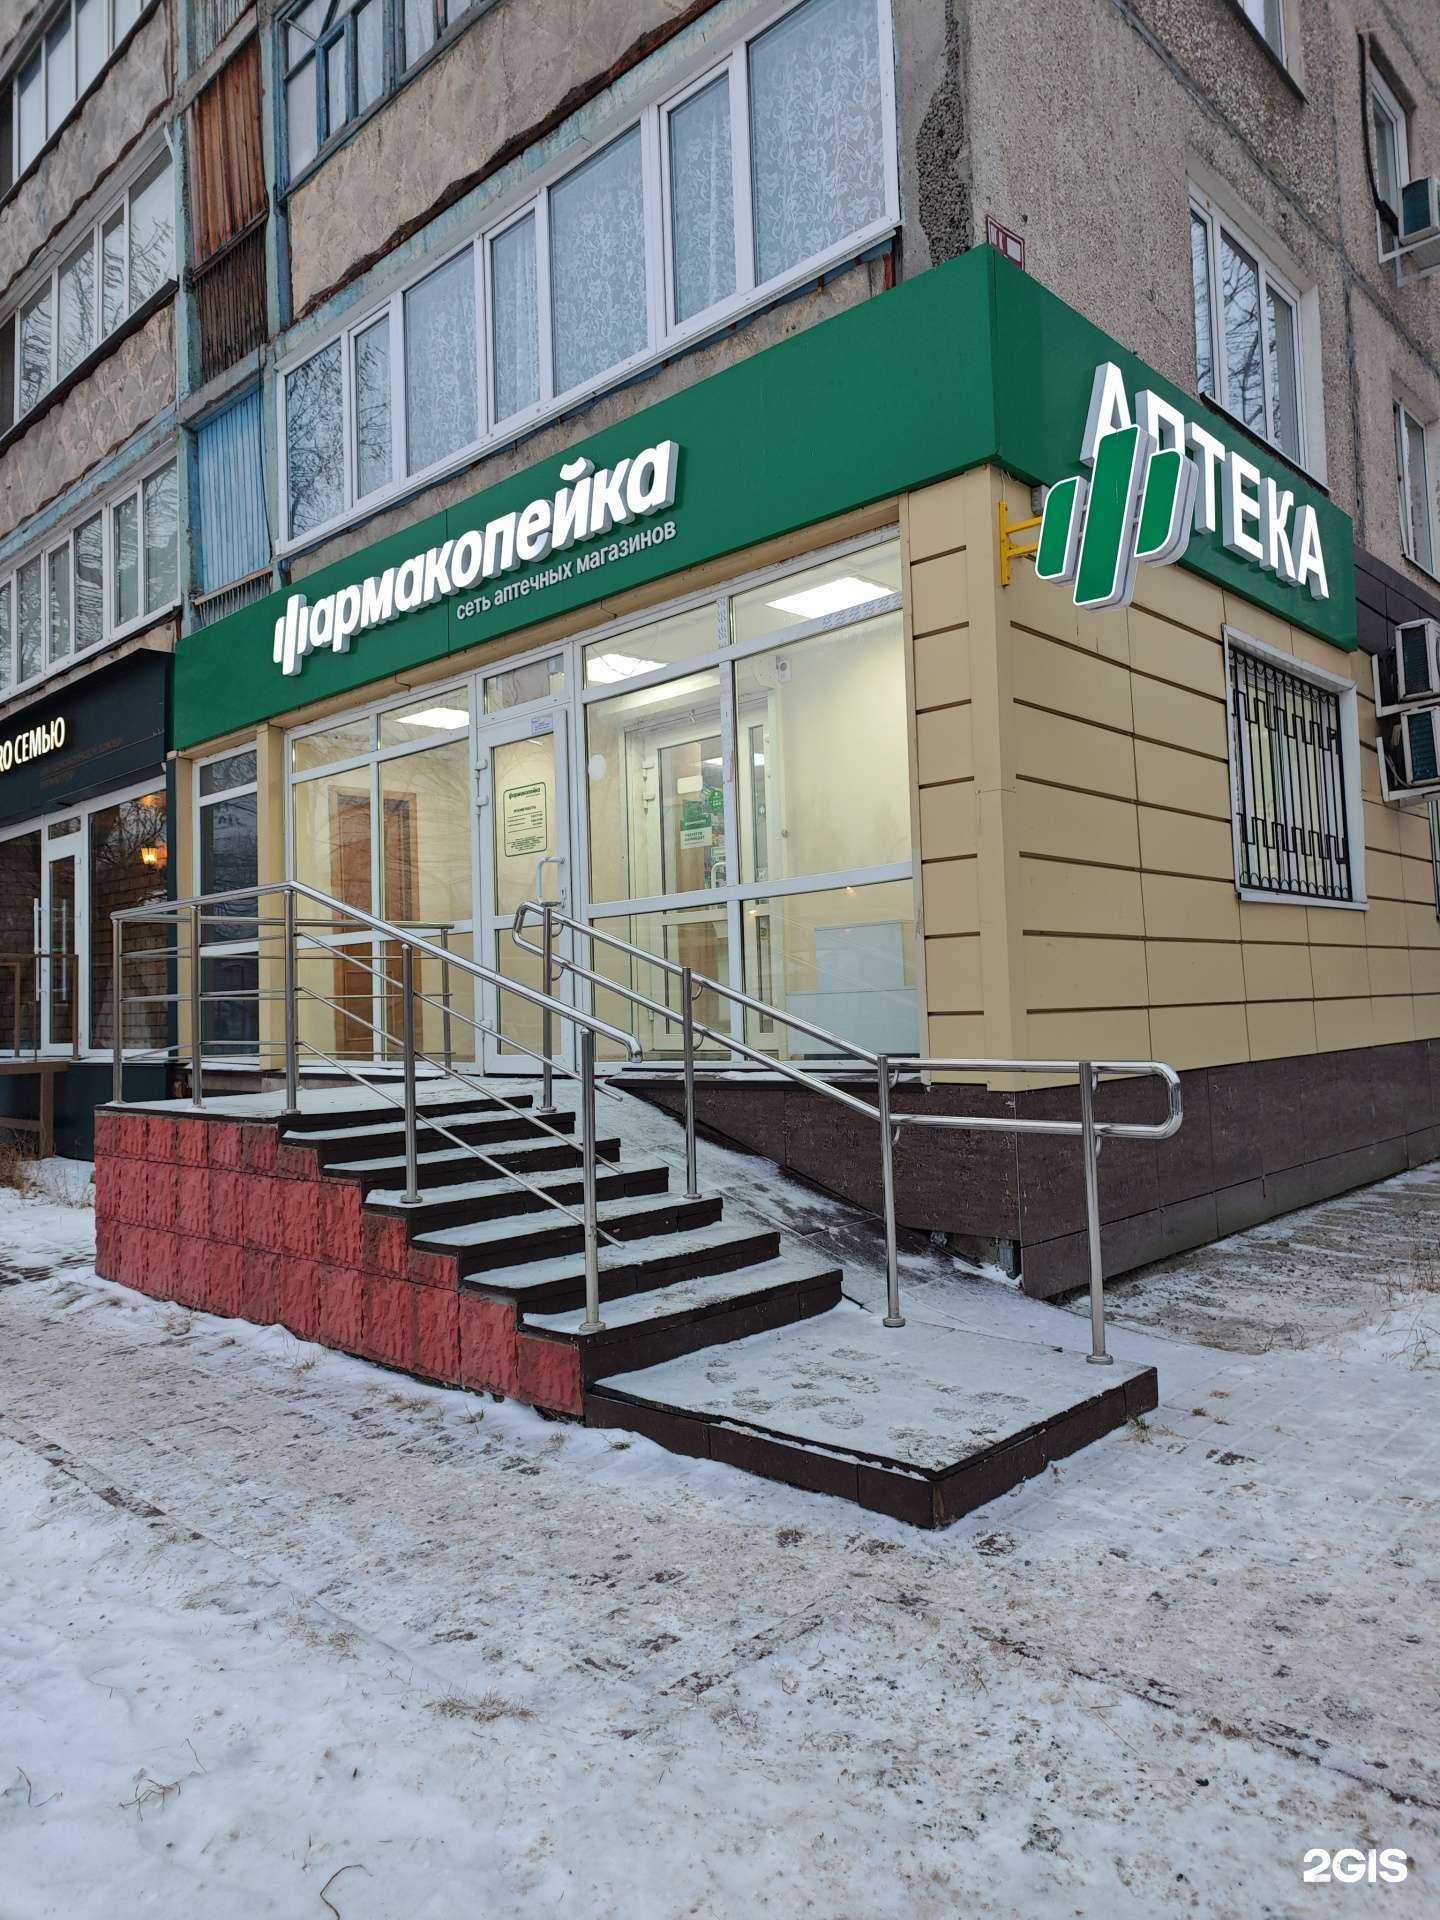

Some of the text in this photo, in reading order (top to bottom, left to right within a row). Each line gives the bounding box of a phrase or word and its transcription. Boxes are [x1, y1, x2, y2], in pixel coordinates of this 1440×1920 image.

[456, 521, 677, 620] сеть аптечных магазинов
[14, 717, 65, 764] СЕМЬЮ
